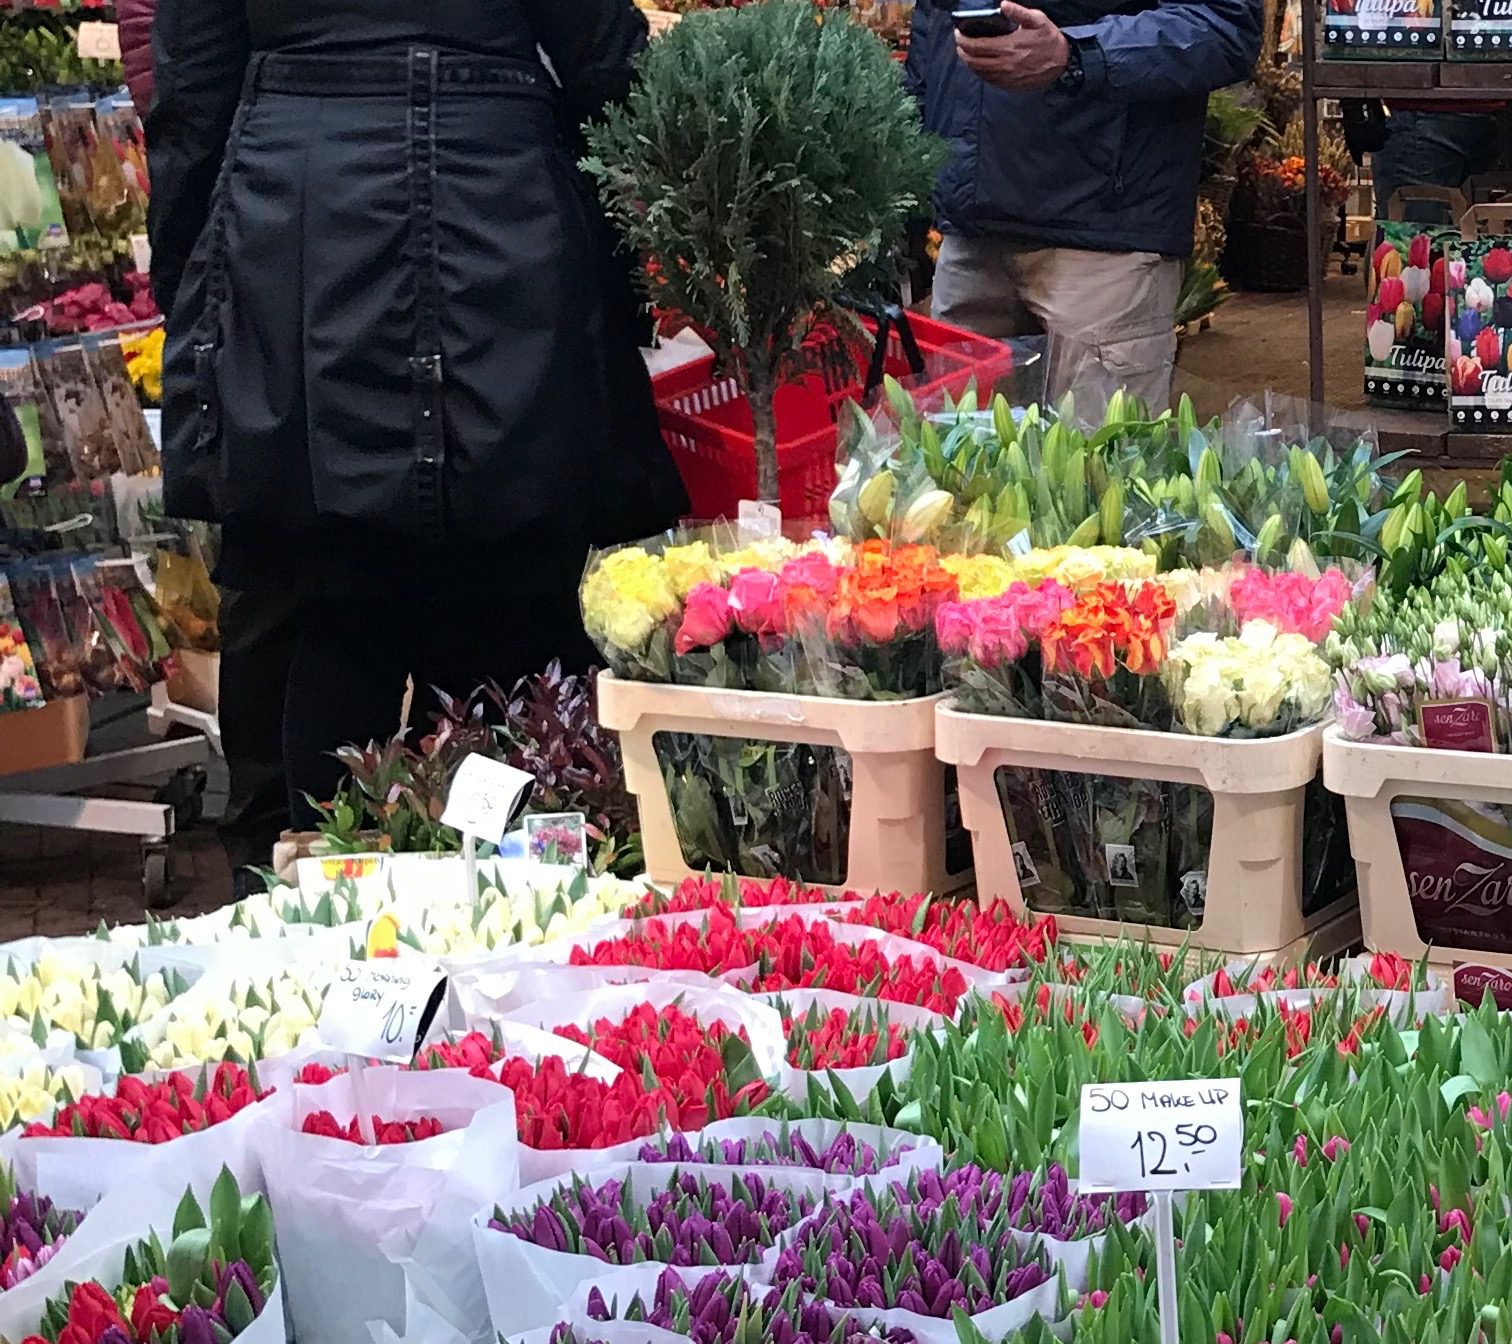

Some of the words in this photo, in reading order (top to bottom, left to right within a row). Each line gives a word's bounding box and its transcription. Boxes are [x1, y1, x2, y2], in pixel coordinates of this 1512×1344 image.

[1389, 345, 1446, 373] Tulipa
[1089, 1087, 1130, 1112] 50
[1141, 1091, 1196, 1109] MAKE
[1198, 1088, 1229, 1105] UP
